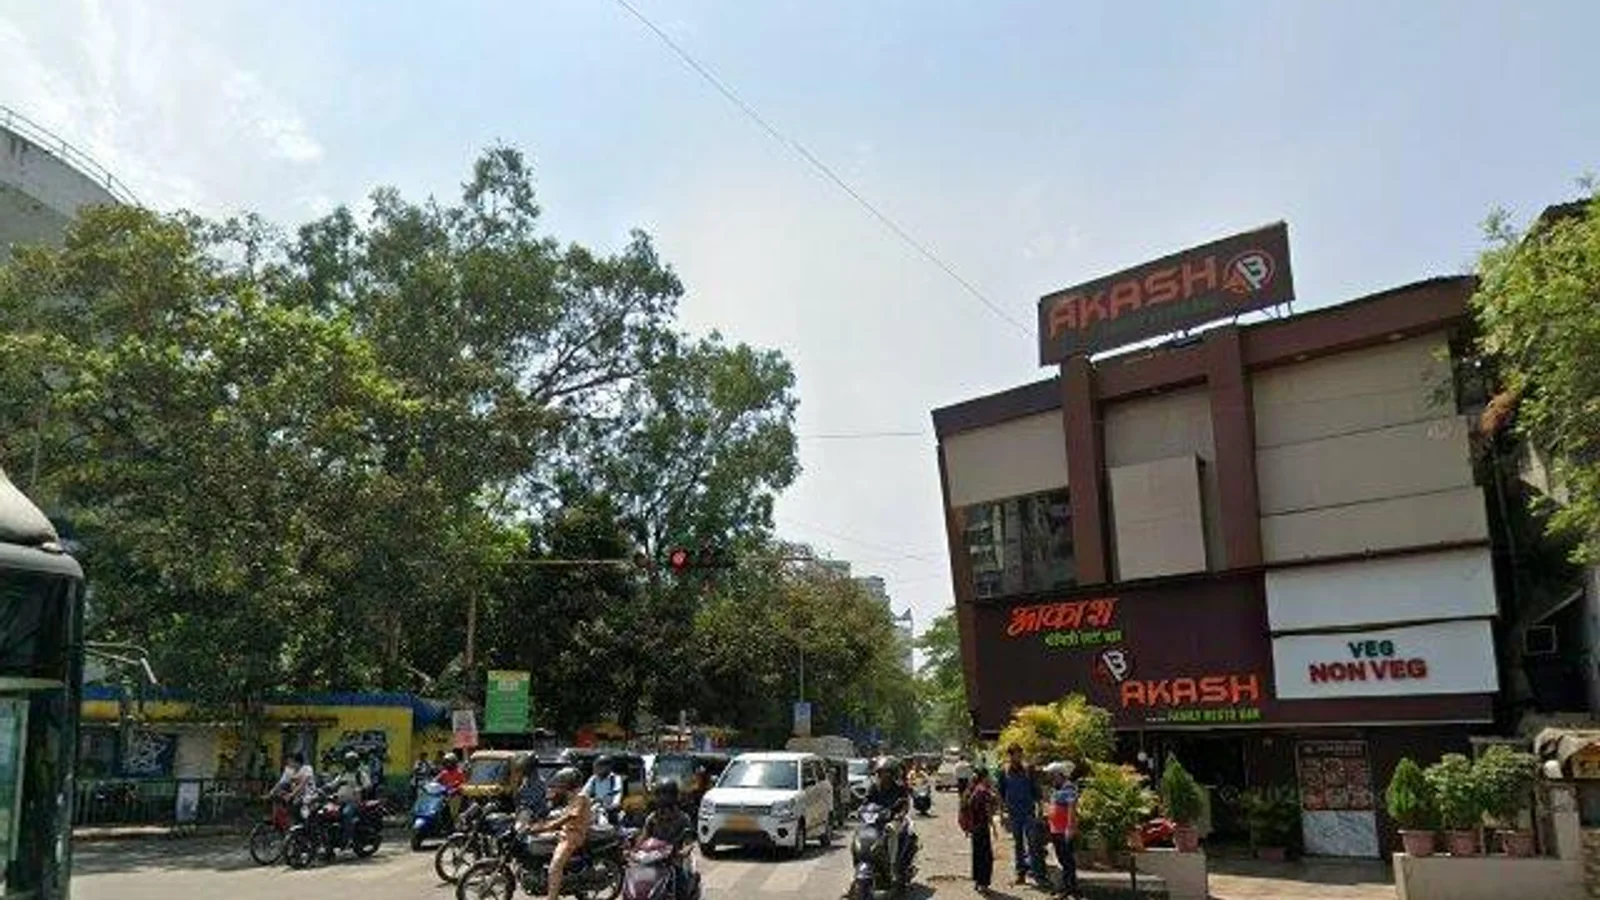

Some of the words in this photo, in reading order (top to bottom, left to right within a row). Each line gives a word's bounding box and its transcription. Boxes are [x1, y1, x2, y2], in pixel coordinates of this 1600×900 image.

[1050, 255, 1217, 339] AKASH
[1348, 640, 1394, 658] VEG
[1309, 662, 1366, 683] NON
[1370, 659, 1427, 679] VEG
[1120, 674, 1259, 706] AKASH
